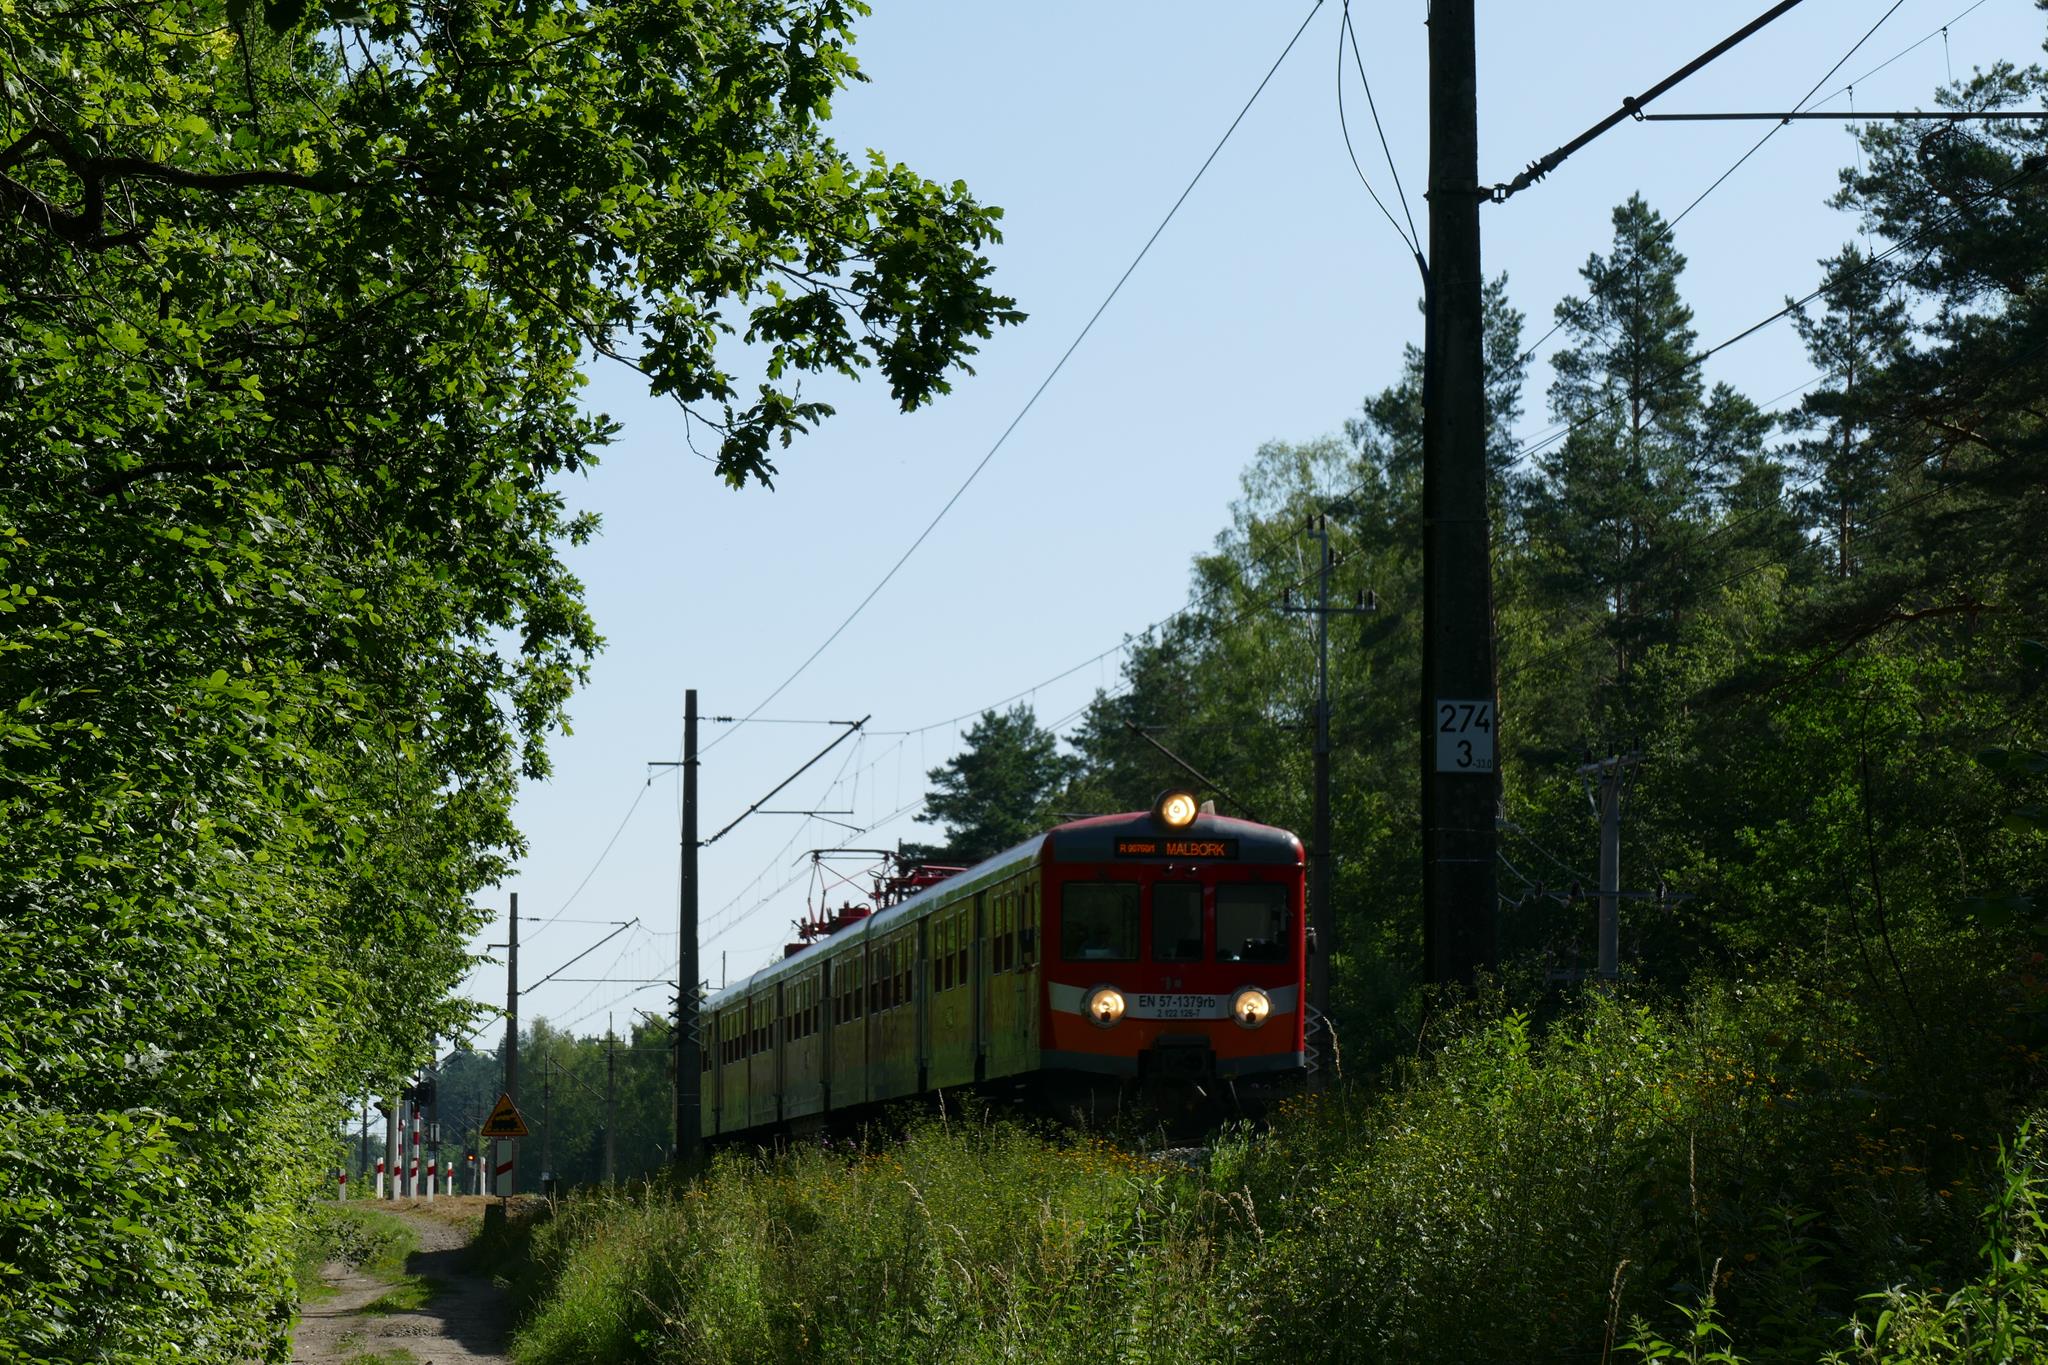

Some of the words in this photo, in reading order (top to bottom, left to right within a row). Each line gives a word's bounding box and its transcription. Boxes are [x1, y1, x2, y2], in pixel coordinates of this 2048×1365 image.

[1440, 704, 1490, 733] 274
[1456, 740, 1472, 768] 3
[1166, 842, 1225, 856] MALBORK
[1139, 995, 1155, 1007] EN
[1159, 995, 1216, 1008] 57-1379rb
